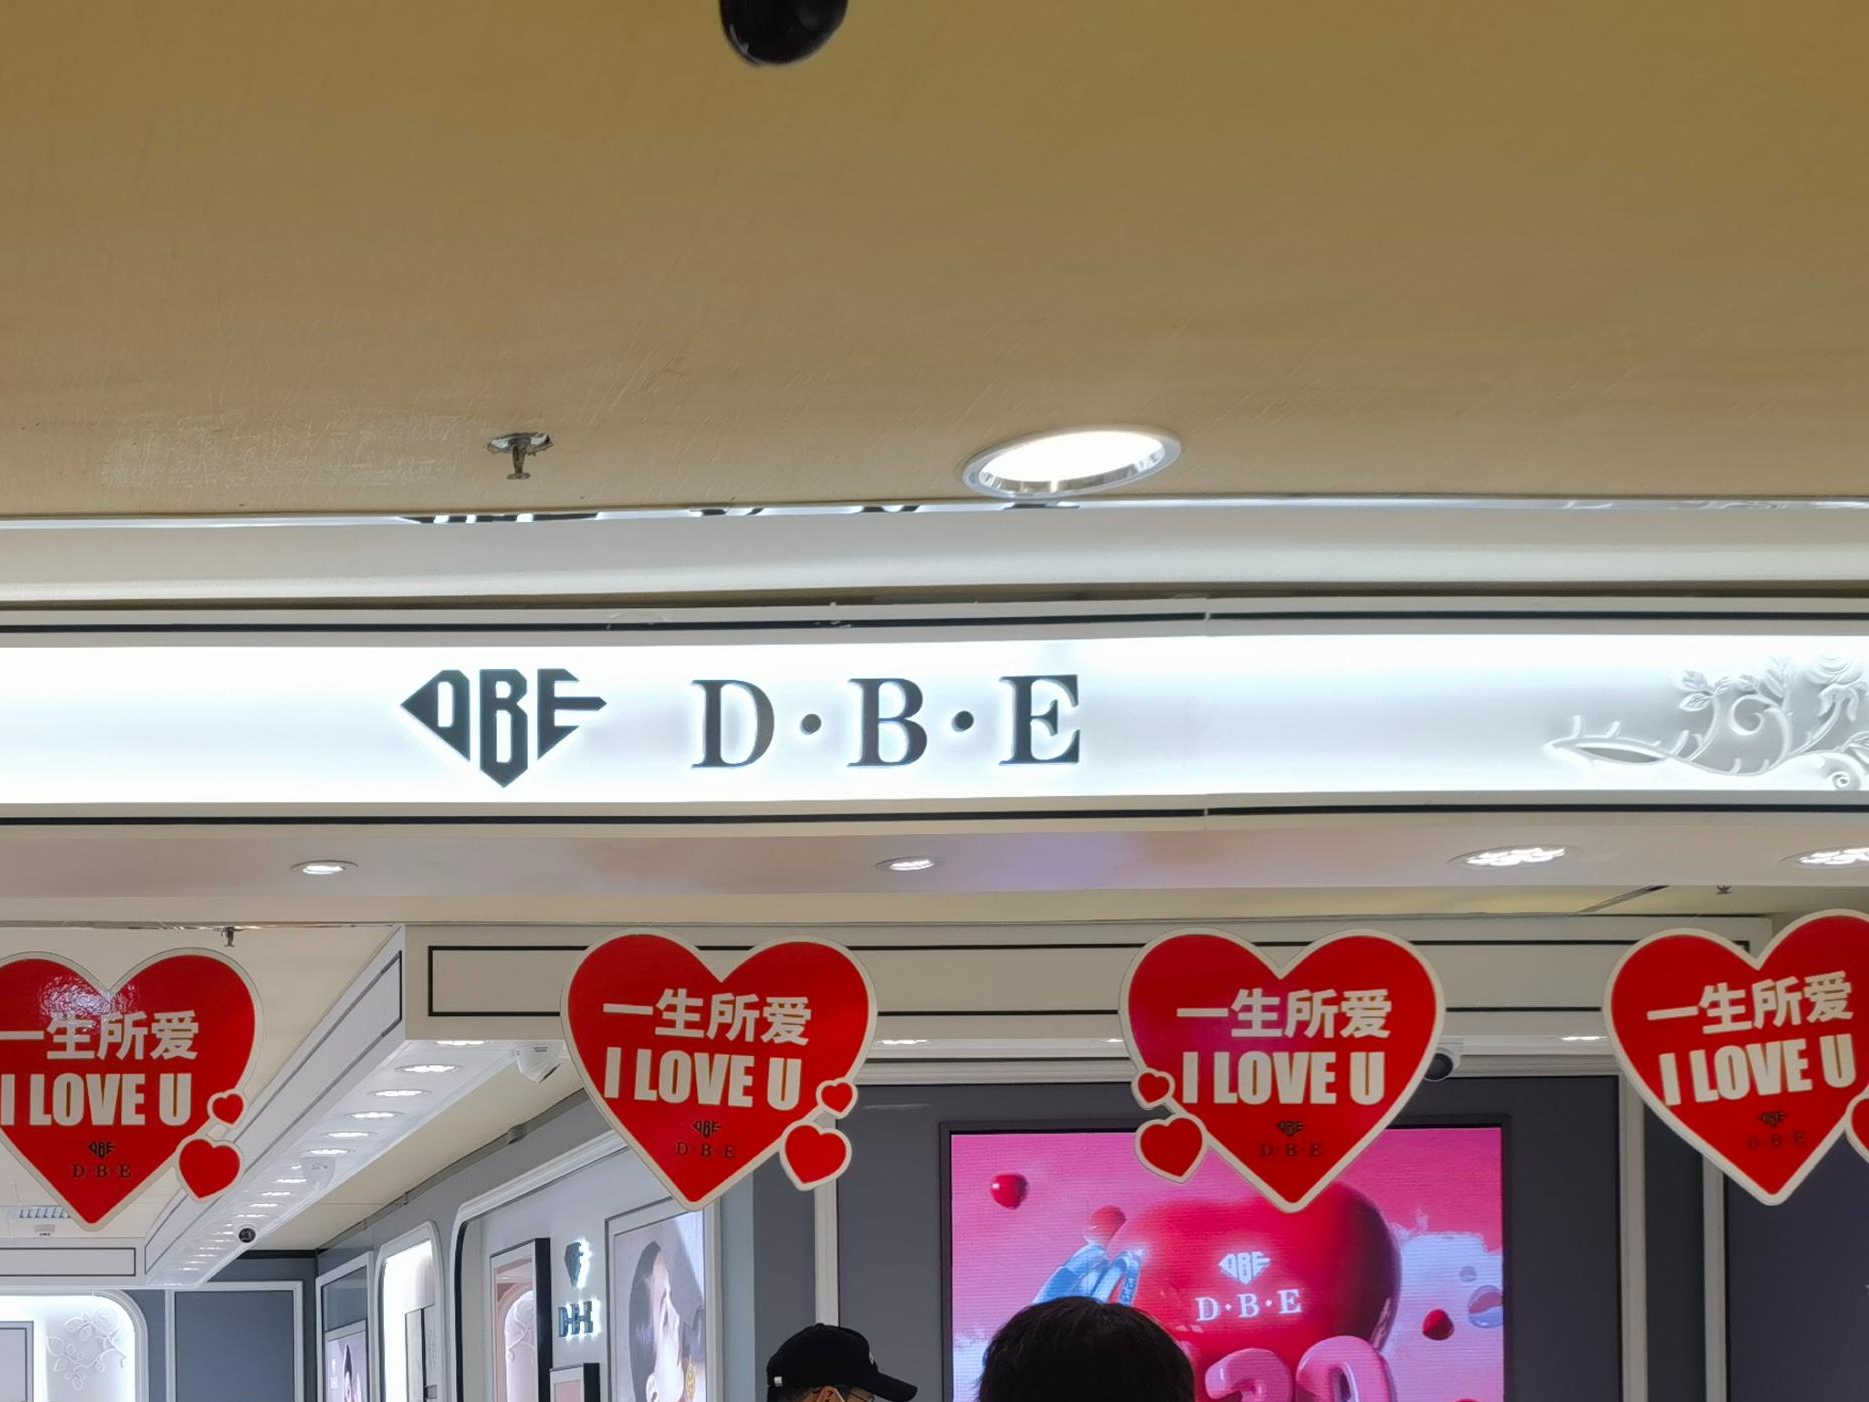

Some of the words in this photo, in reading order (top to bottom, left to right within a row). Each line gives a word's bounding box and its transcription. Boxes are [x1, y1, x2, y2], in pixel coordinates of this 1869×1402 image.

[603, 988, 812, 1046] 一生所爱
[1176, 988, 1392, 1039] 一生所爱
[1646, 970, 1854, 1035] 一生所爱
[603, 1046, 622, 1098] I
[634, 1048, 755, 1108] LOVE
[766, 1057, 802, 1111] U
[1182, 1051, 1199, 1104] I
[1213, 1050, 1337, 1105] LOVE
[1350, 1051, 1385, 1105] U
[1659, 1052, 1682, 1106] I
[1689, 1038, 1813, 1103] LOVE
[1819, 1033, 1857, 1088] U
[0, 1074, 15, 1126] I
[30, 1072, 146, 1126] LOVE
[159, 1073, 192, 1126] U
